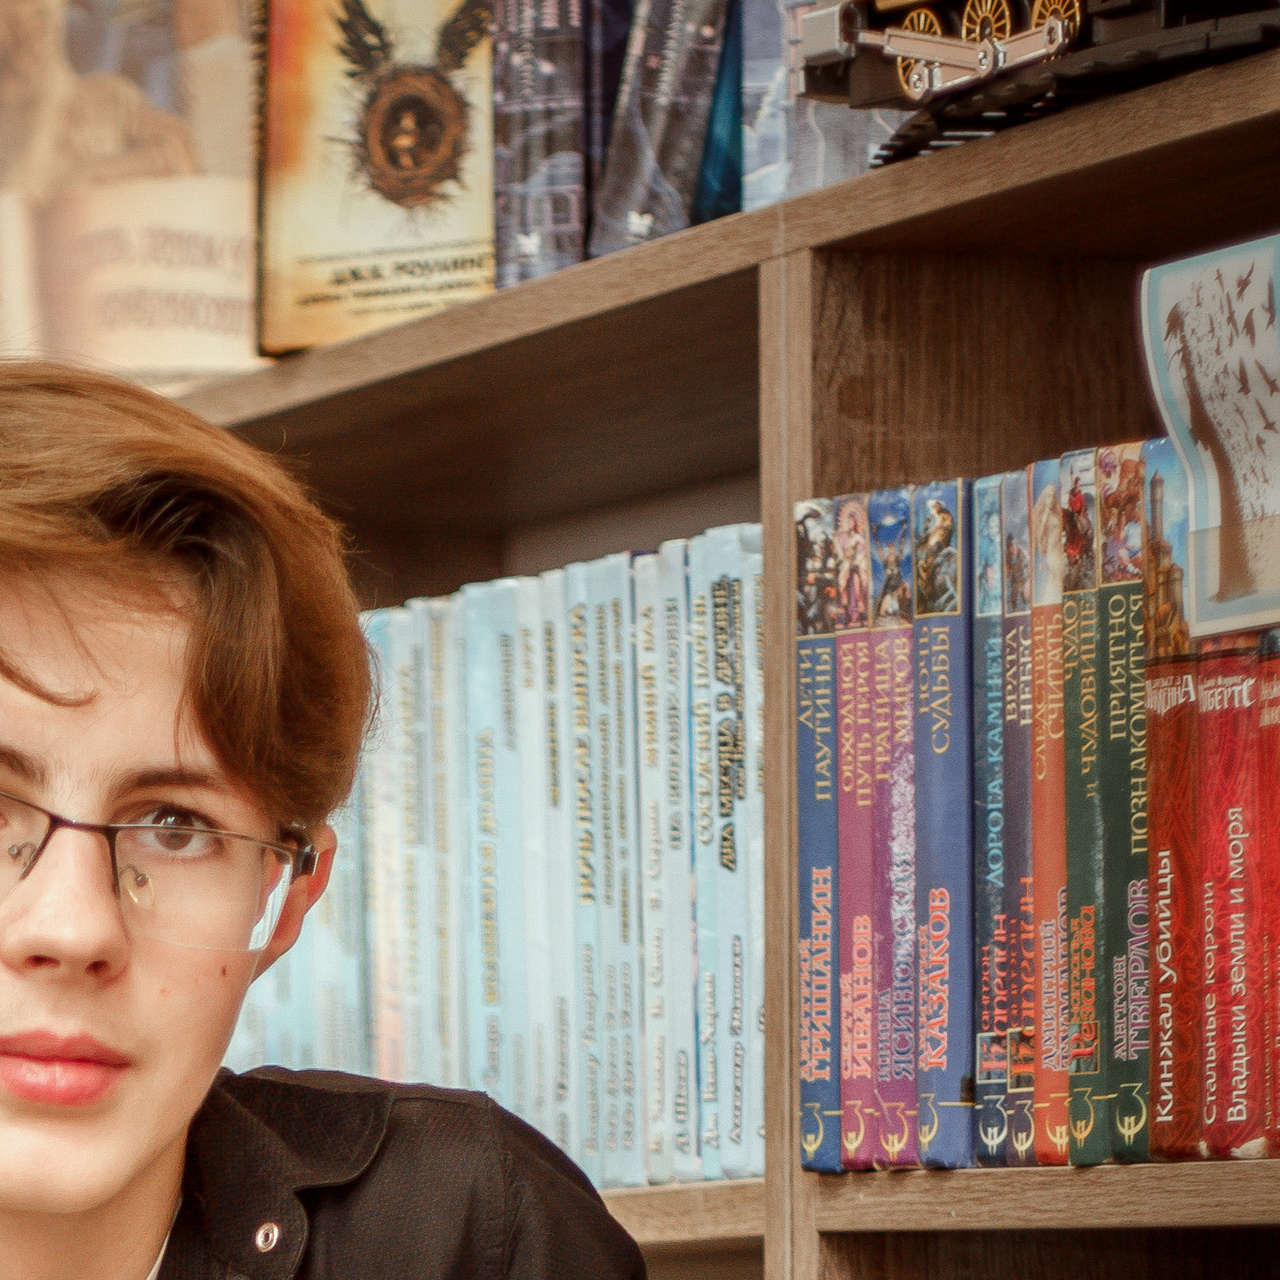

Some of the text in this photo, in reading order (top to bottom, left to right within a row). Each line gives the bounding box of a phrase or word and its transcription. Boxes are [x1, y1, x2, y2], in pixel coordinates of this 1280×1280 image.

[799, 648, 814, 729] ДЕТИ
[874, 640, 892, 780] ГРАНИЦА
[892, 637, 910, 744] МИРОВ
[918, 626, 930, 714] НОЧЬ
[930, 625, 952, 755] СУДЬБЫ
[1005, 626, 1018, 721] ВРАТА
[1019, 625, 1032, 726] НЕБЕС
[1034, 615, 1047, 781] СЛЕДСТВИЕ
[1047, 613, 1064, 739] СЧИТАТЬ
[1063, 600, 1078, 680] ЧУДО
[1079, 598, 1098, 775] ЧУДОВИЩЕ
[1109, 594, 1127, 741] ПРИЯТНО
[572, 604, 595, 904] НОЧЬ ПОСЛЕ ВЫПУСКА
[692, 592, 712, 844] СОСЕДСКИЙ ПАРЕНЬ
[718, 718, 733, 818] МЕСЯЦА
[815, 647, 832, 801] ПАУТИНЫ
[841, 641, 855, 792] ОБХОДНОЙ
[855, 641, 871, 807] ПУТЬ ГЕРОЯ
[986, 637, 1004, 888] ДОРОГА КАМНЕЙ
[1129, 594, 1148, 855] ПОЗНАКОМИТЬСЯ
[719, 822, 736, 871] ДВА
[800, 939, 812, 1082] ДМИТРИЙ
[812, 866, 832, 1081] ГРИШАНИН
[840, 972, 853, 1080] СЕРГЕЙ
[853, 915, 872, 1080] ИВАНОВ
[878, 990, 891, 1082] ИРИНА
[928, 888, 950, 1070] КАЗАКОВ
[1041, 919, 1057, 1069] ДМИТРИЙ
[1113, 955, 1127, 1061] АНТОН
[1155, 849, 1177, 1122] Кинжал убийцы
[1203, 881, 1218, 1125] Стальные короли
[1227, 807, 1249, 1122] Владыки земли и моря
